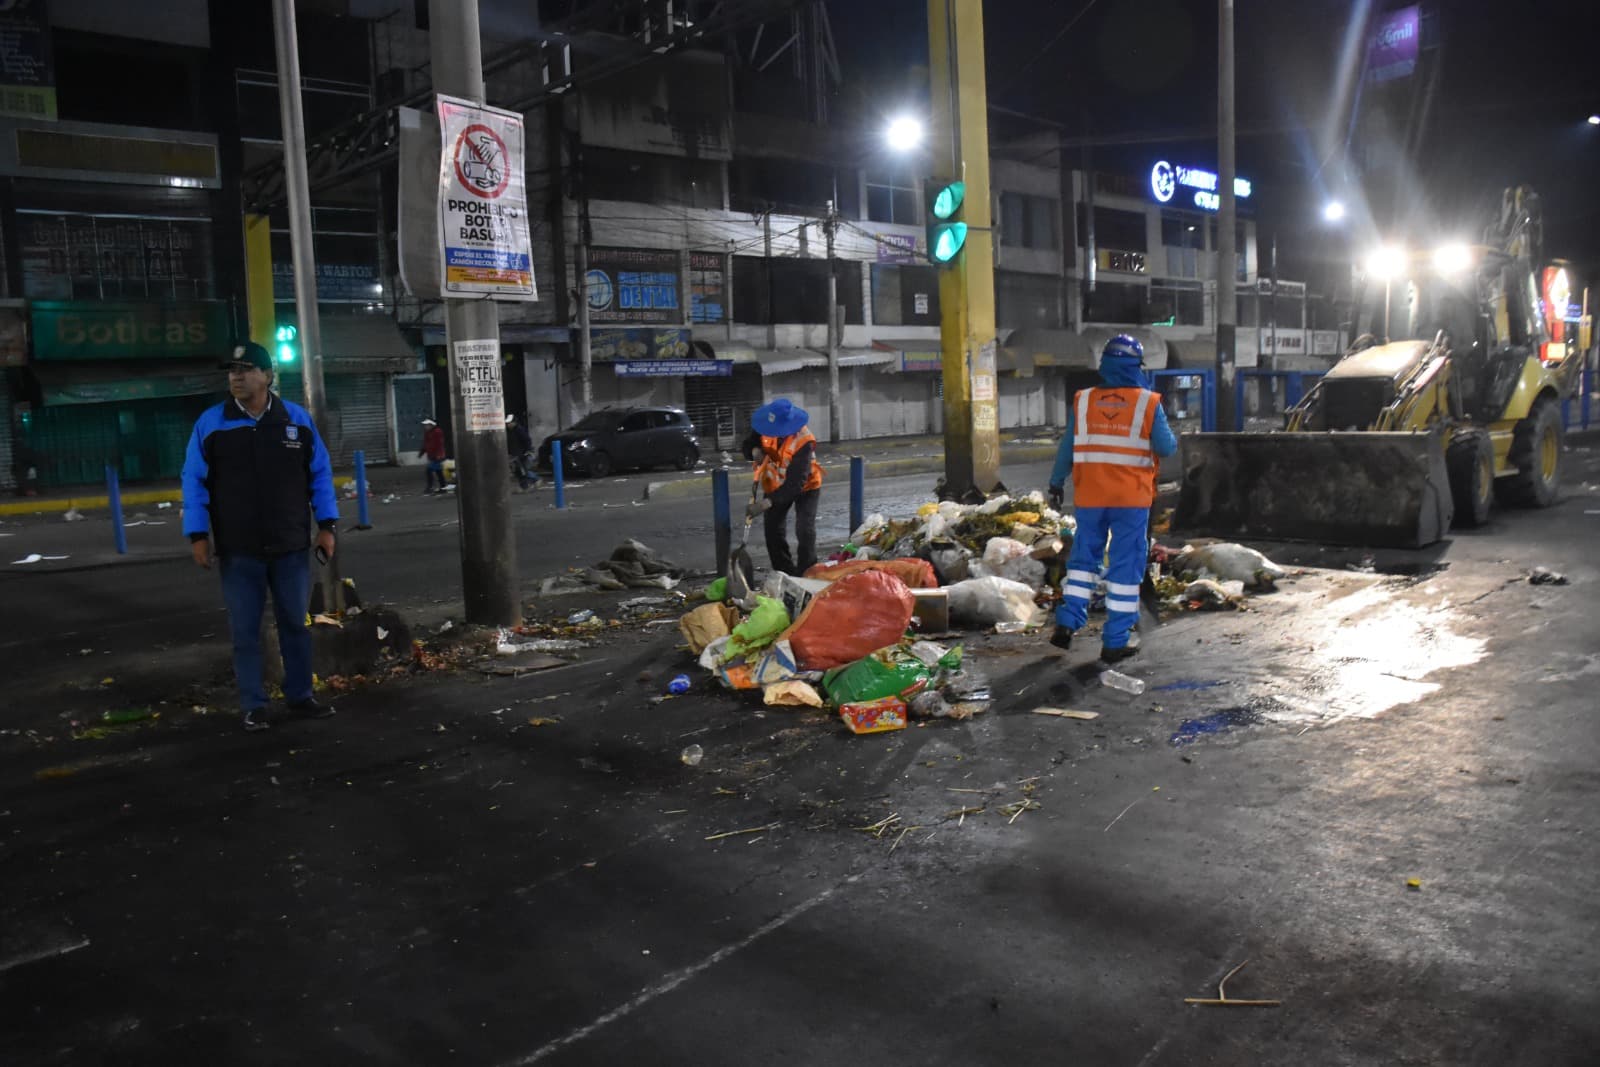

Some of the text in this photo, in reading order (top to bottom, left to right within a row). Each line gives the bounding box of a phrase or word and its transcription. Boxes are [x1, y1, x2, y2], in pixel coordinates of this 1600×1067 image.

[465, 215, 510, 228] BOT
[460, 228, 512, 243] BASU
[618, 285, 679, 309] DENTAL
[57, 313, 208, 345] Boticas
[1265, 336, 1301, 348] EPINAR
